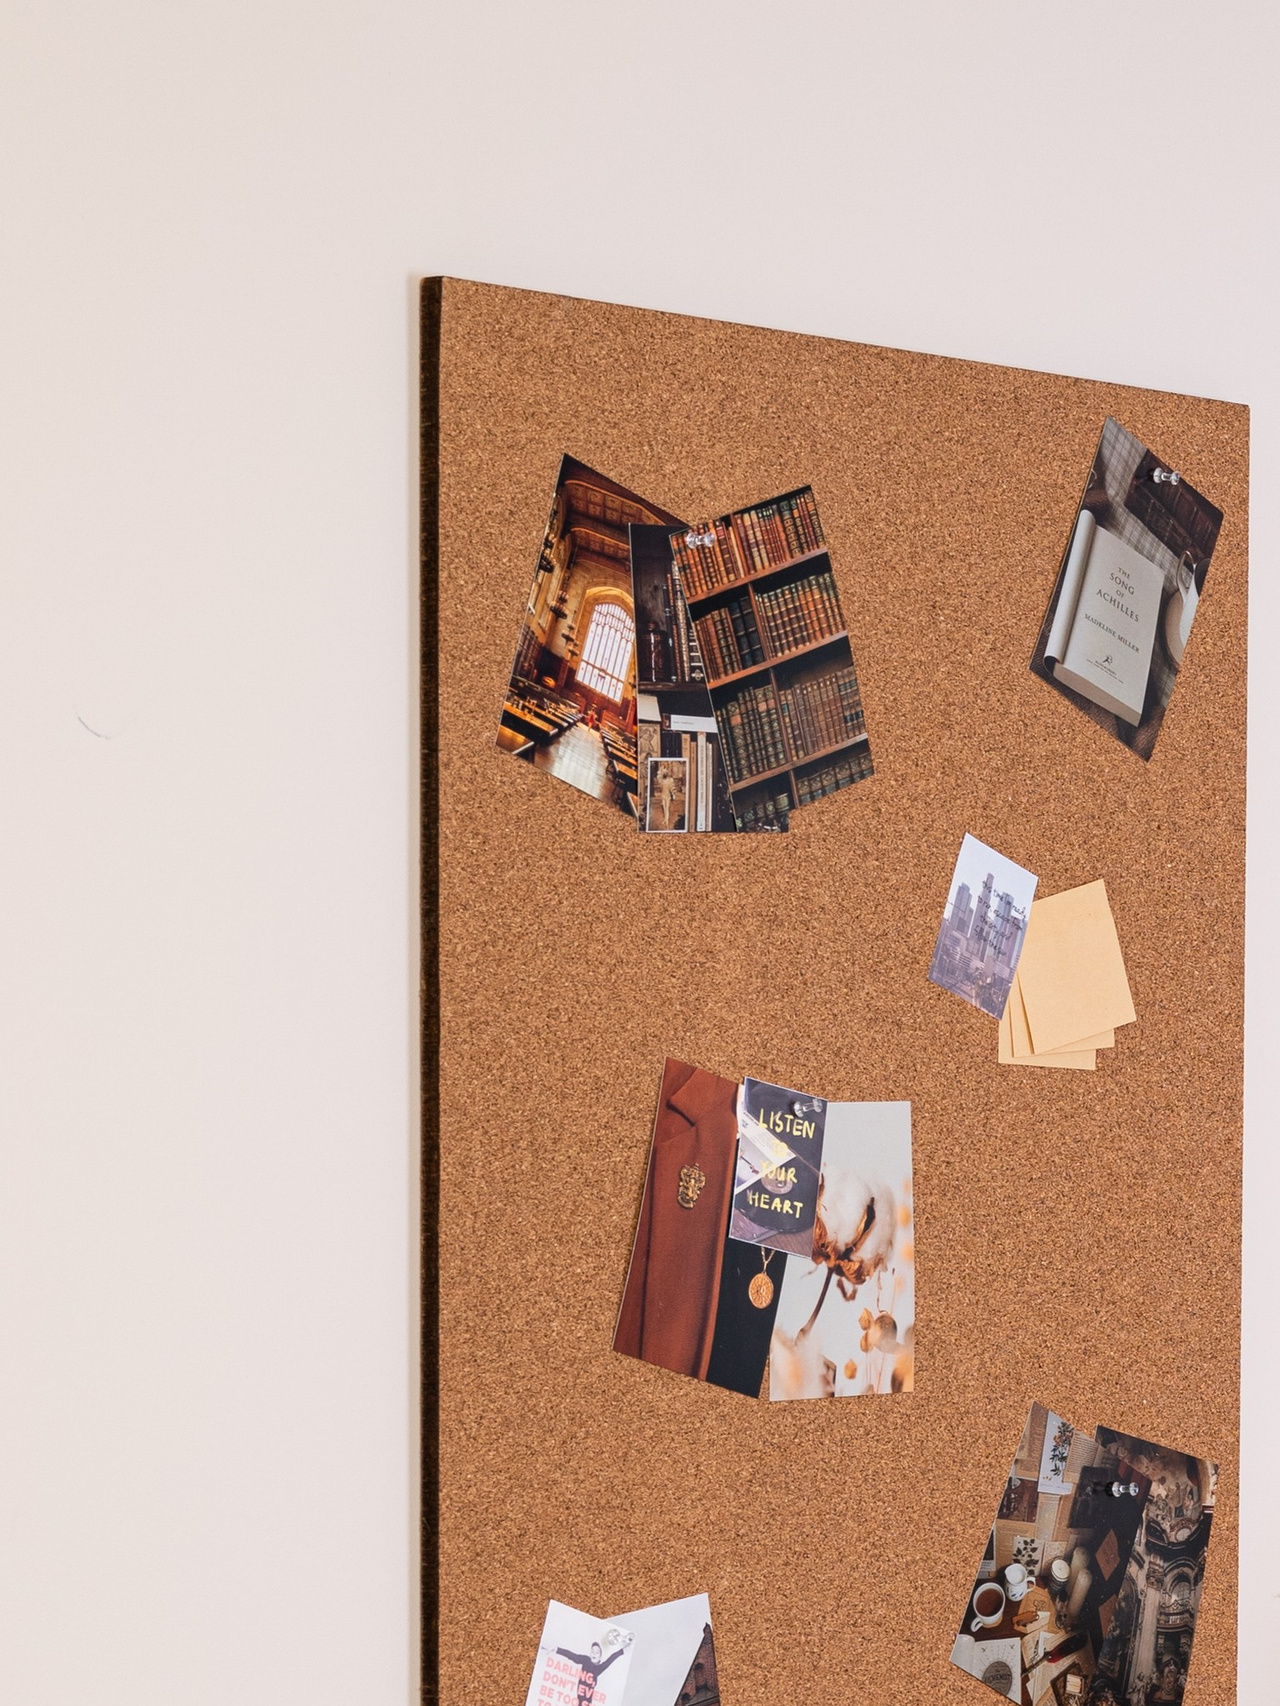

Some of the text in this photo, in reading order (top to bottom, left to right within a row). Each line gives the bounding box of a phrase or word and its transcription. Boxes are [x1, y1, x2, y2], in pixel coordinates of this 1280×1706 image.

[1110, 573, 1134, 595] SONG
[1116, 590, 1124, 598] OF
[1096, 588, 1140, 622] ACHILLES
[1084, 614, 1140, 653] MADELINE MILLER
[760, 1108, 815, 1139] LISTEN
[773, 1140, 789, 1158] TO
[761, 1161, 798, 1183] YOUR
[748, 1190, 803, 1218] HEART
[546, 1657, 596, 1687] DARLING,
[540, 1685, 555, 1698] BE
[557, 1691, 579, 1706] TOO
[543, 1671, 606, 1704] DON'T EVER
